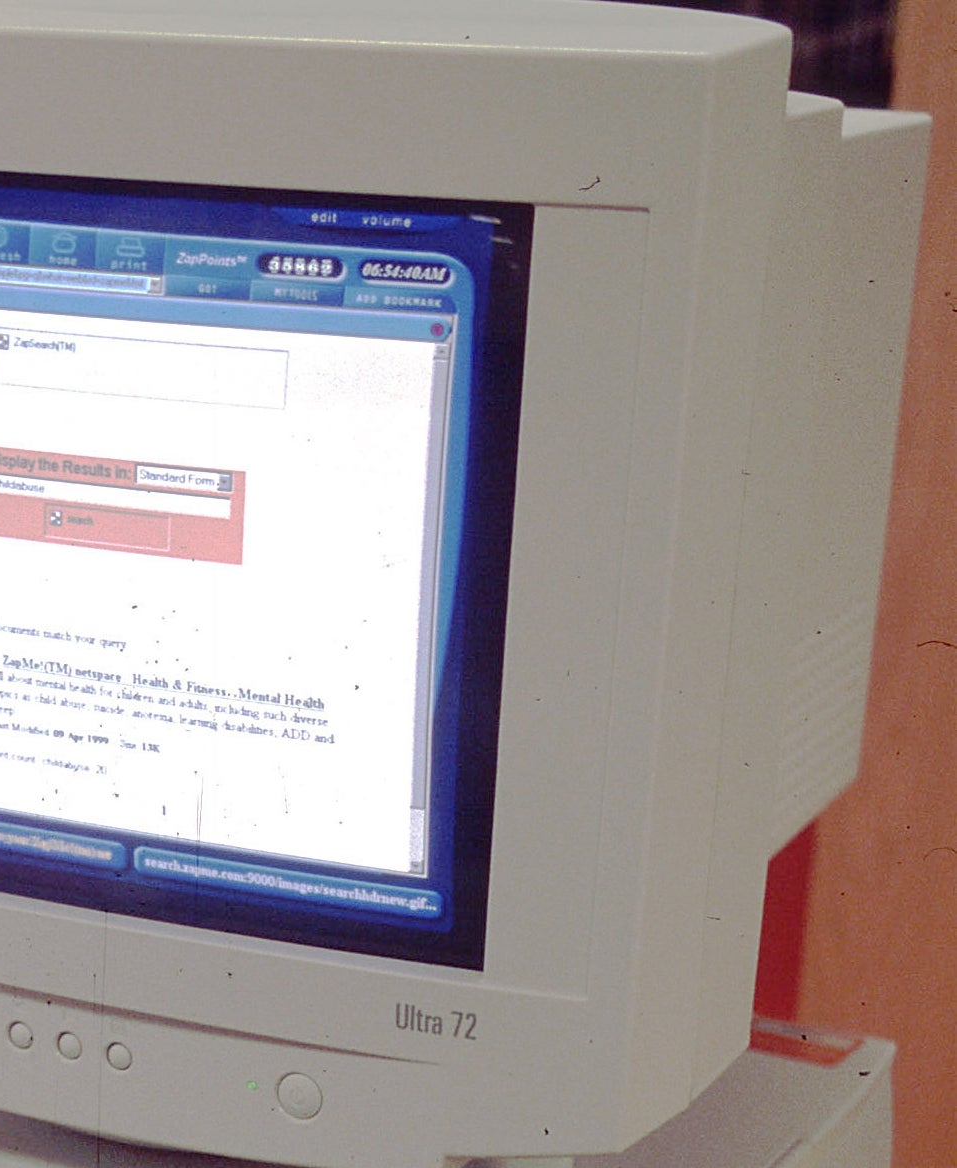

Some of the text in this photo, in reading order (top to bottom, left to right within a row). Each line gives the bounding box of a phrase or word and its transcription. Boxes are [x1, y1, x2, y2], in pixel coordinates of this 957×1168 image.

[310, 212, 337, 223] edit
[362, 215, 412, 228] volume
[49, 255, 78, 266] home
[110, 259, 147, 271] print
[362, 263, 447, 281] 06:54:40AM
[356, 293, 442, 308] ADD BOOKMARK
[38, 457, 60, 473] the
[63, 460, 111, 478] Results
[115, 465, 132, 480] in:
[139, 468, 215, 487] Standard Form
[43, 631, 72, 642] match
[75, 635, 96, 645] your
[99, 638, 127, 649] query
[75, 668, 122, 683] netspace
[132, 673, 169, 689] Health
[173, 680, 183, 690] &
[238, 687, 281, 704] Mental
[285, 693, 325, 709] Health
[7, 673, 33, 685] about
[35, 678, 66, 691] mental
[69, 682, 96, 695] health
[99, 686, 113, 698] for
[116, 689, 155, 704] children
[158, 696, 176, 707] and
[215, 704, 260, 720] including
[264, 710, 287, 722] such
[291, 712, 329, 727] diverse
[35, 695, 56, 706] child
[179, 714, 218, 731] learning
[281, 728, 310, 741] ADD
[315, 734, 335, 744] and
[53, 729, 65, 738] 09
[68, 732, 83, 743] Apr
[87, 735, 109, 744] 1999
[395, 1003, 478, 1041] Ultra 72
